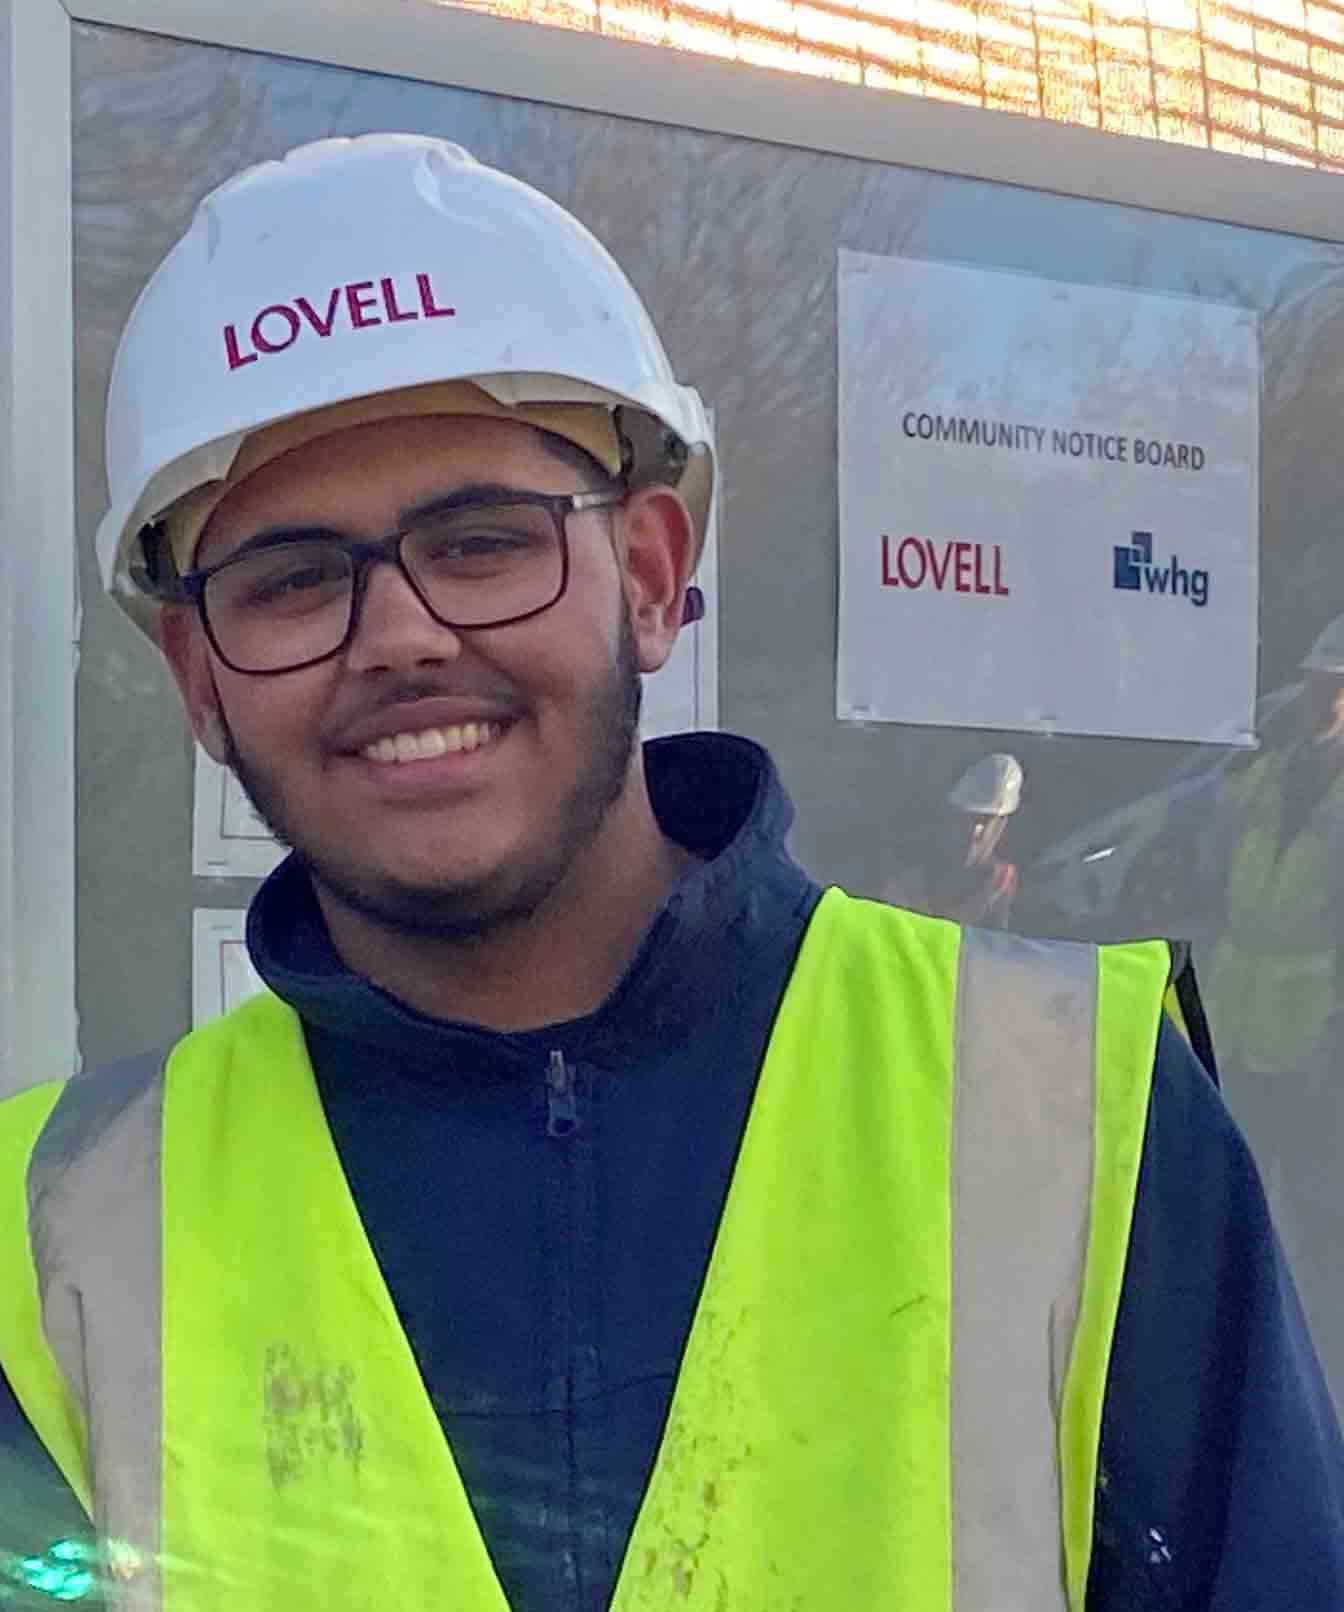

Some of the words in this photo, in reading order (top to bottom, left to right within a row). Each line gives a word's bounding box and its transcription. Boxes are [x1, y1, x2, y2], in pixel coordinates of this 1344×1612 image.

[223, 273, 455, 370] LOVELL
[902, 412, 1046, 453] COMMUNITY
[1053, 430, 1128, 463] NOTICE
[1134, 440, 1205, 470] BOARD
[881, 534, 1009, 596] LOVELL
[1144, 554, 1208, 607] whg
